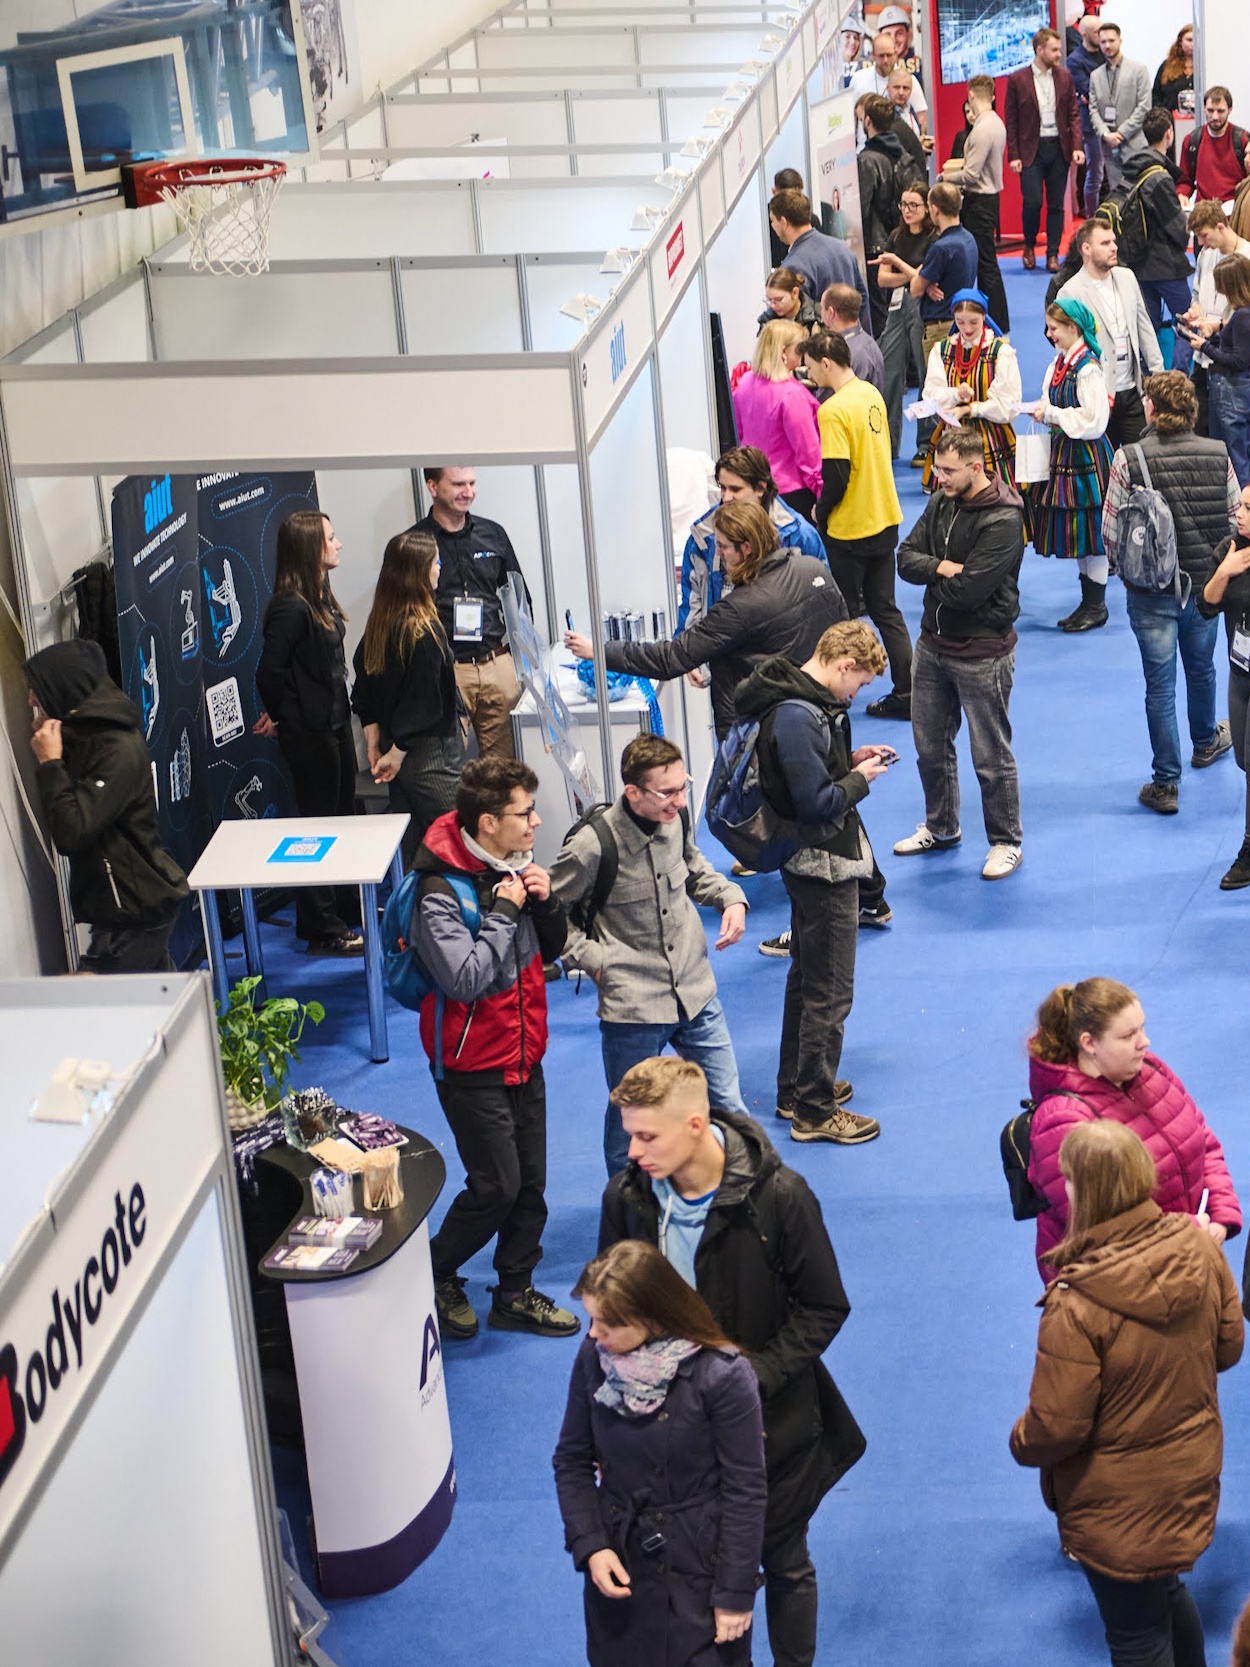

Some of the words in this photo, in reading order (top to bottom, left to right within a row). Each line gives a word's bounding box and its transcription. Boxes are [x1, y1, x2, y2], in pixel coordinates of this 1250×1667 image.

[610, 317, 627, 385] aiut
[143, 473, 174, 535] aiut
[218, 486, 265, 513] www.aiut.com
[160, 511, 187, 544] TECHNOLOGY
